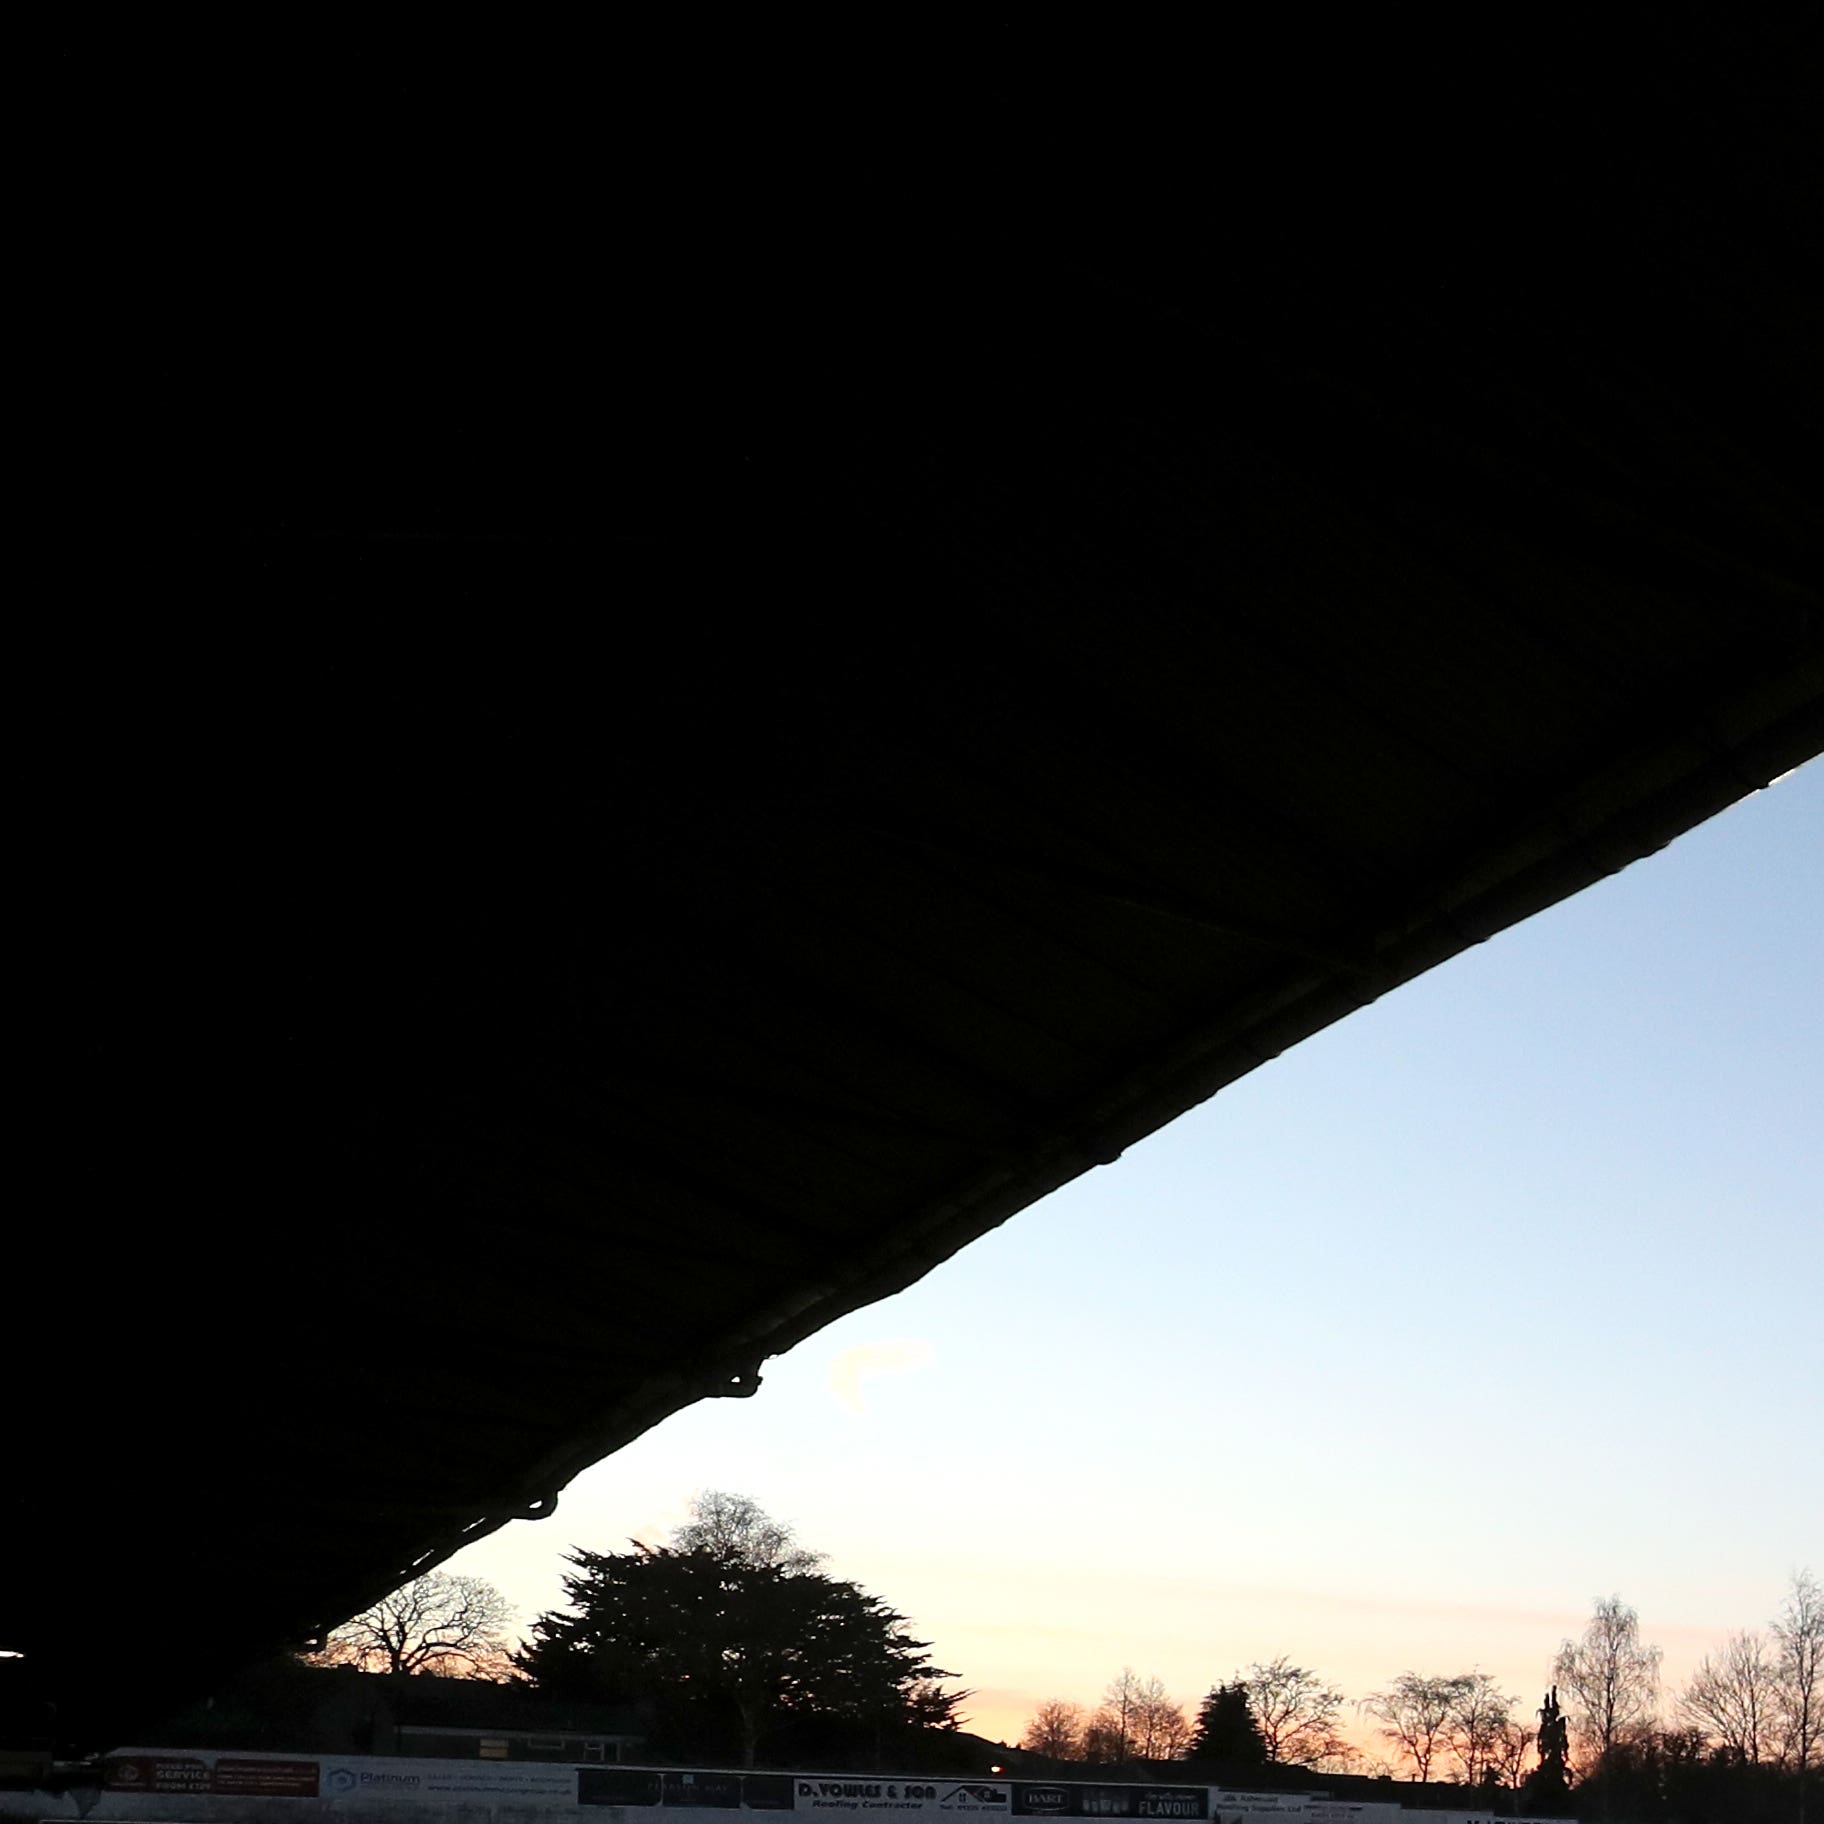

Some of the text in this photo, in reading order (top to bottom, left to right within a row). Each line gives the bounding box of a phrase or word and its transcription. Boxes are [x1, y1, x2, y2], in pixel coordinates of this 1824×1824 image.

[361, 1772, 420, 1784] Platinum
[887, 1785, 898, 1799] &
[812, 1800, 923, 1810] Roofing Contractor
[1138, 1800, 1200, 1816] FLAVOUR
